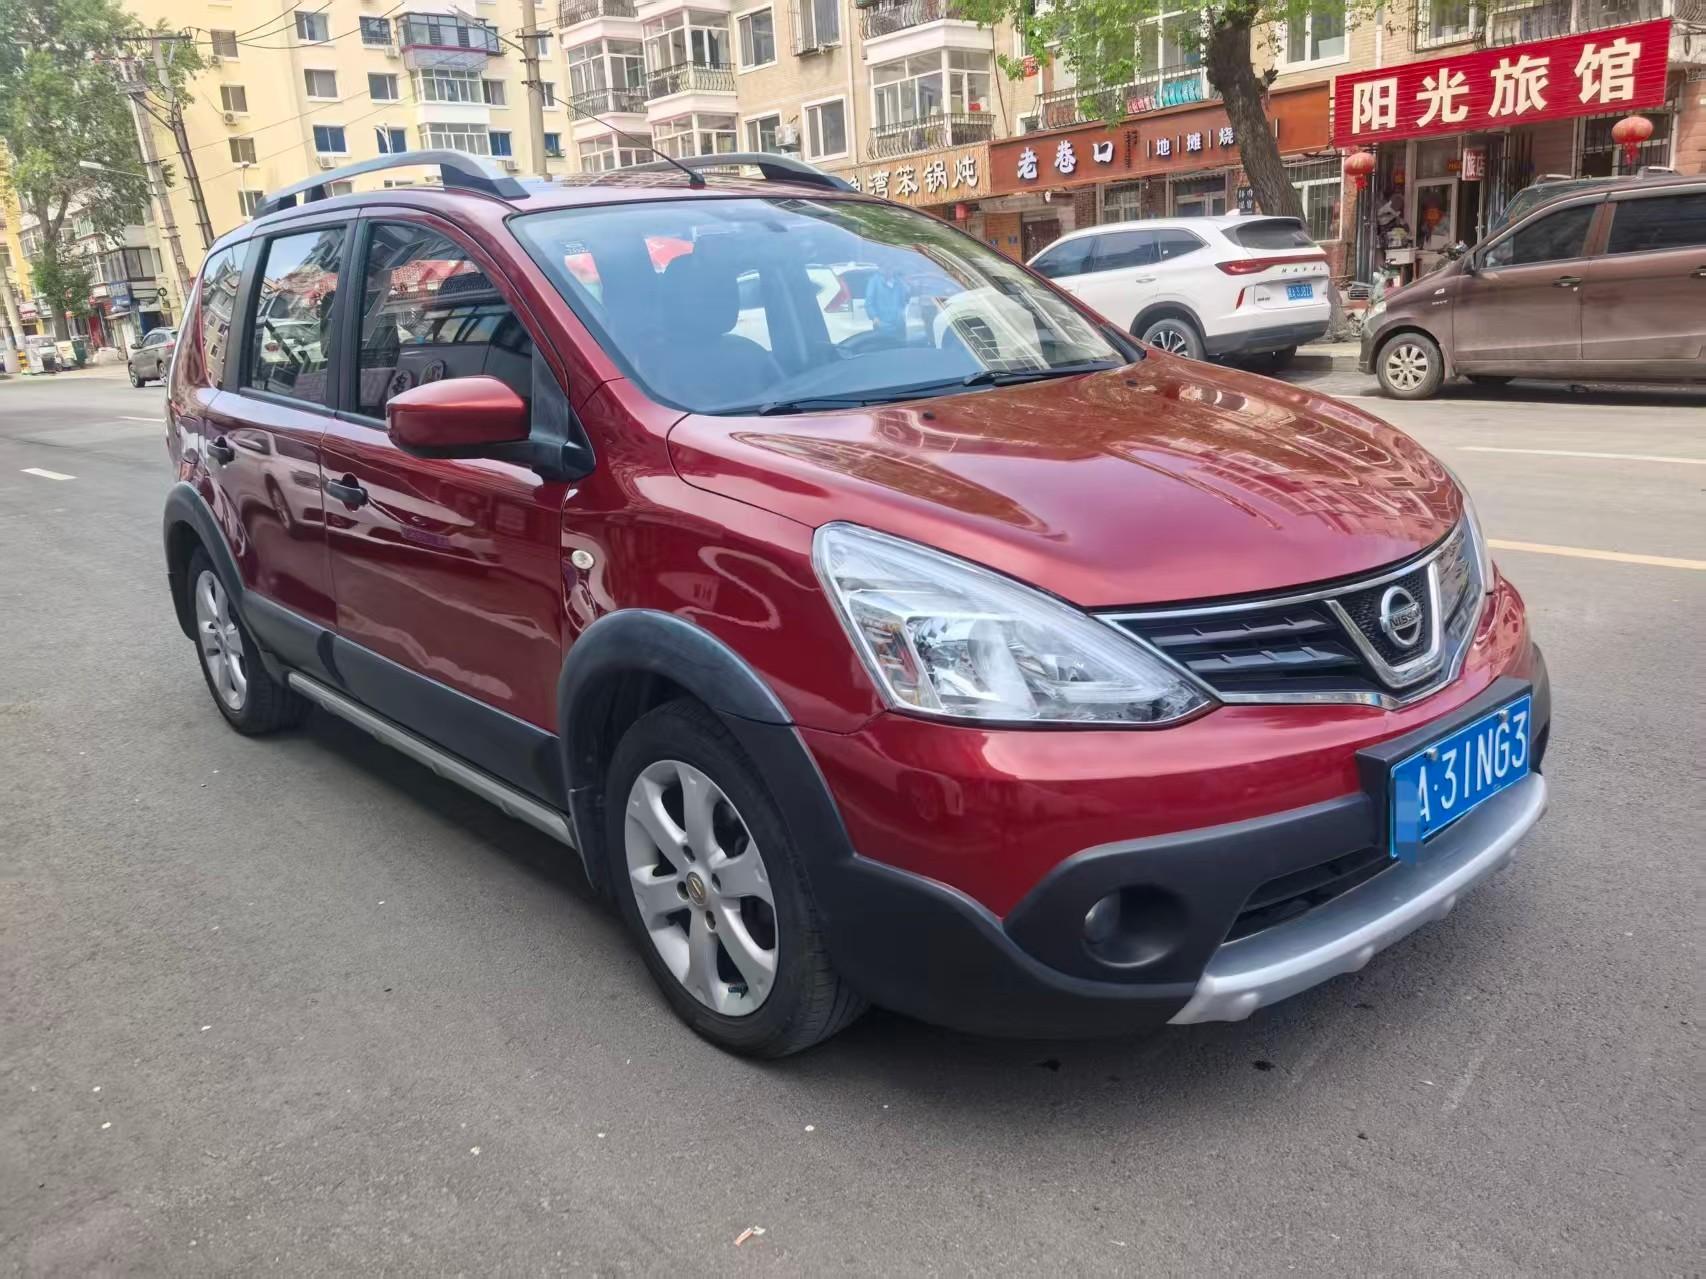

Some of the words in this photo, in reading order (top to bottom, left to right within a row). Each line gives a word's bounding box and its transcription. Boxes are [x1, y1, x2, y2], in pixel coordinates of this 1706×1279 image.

[1352, 37, 1641, 134] 阳光旅馆
[1018, 140, 1113, 179] 老巷口
[1397, 710, 1528, 835] A·31NG3
